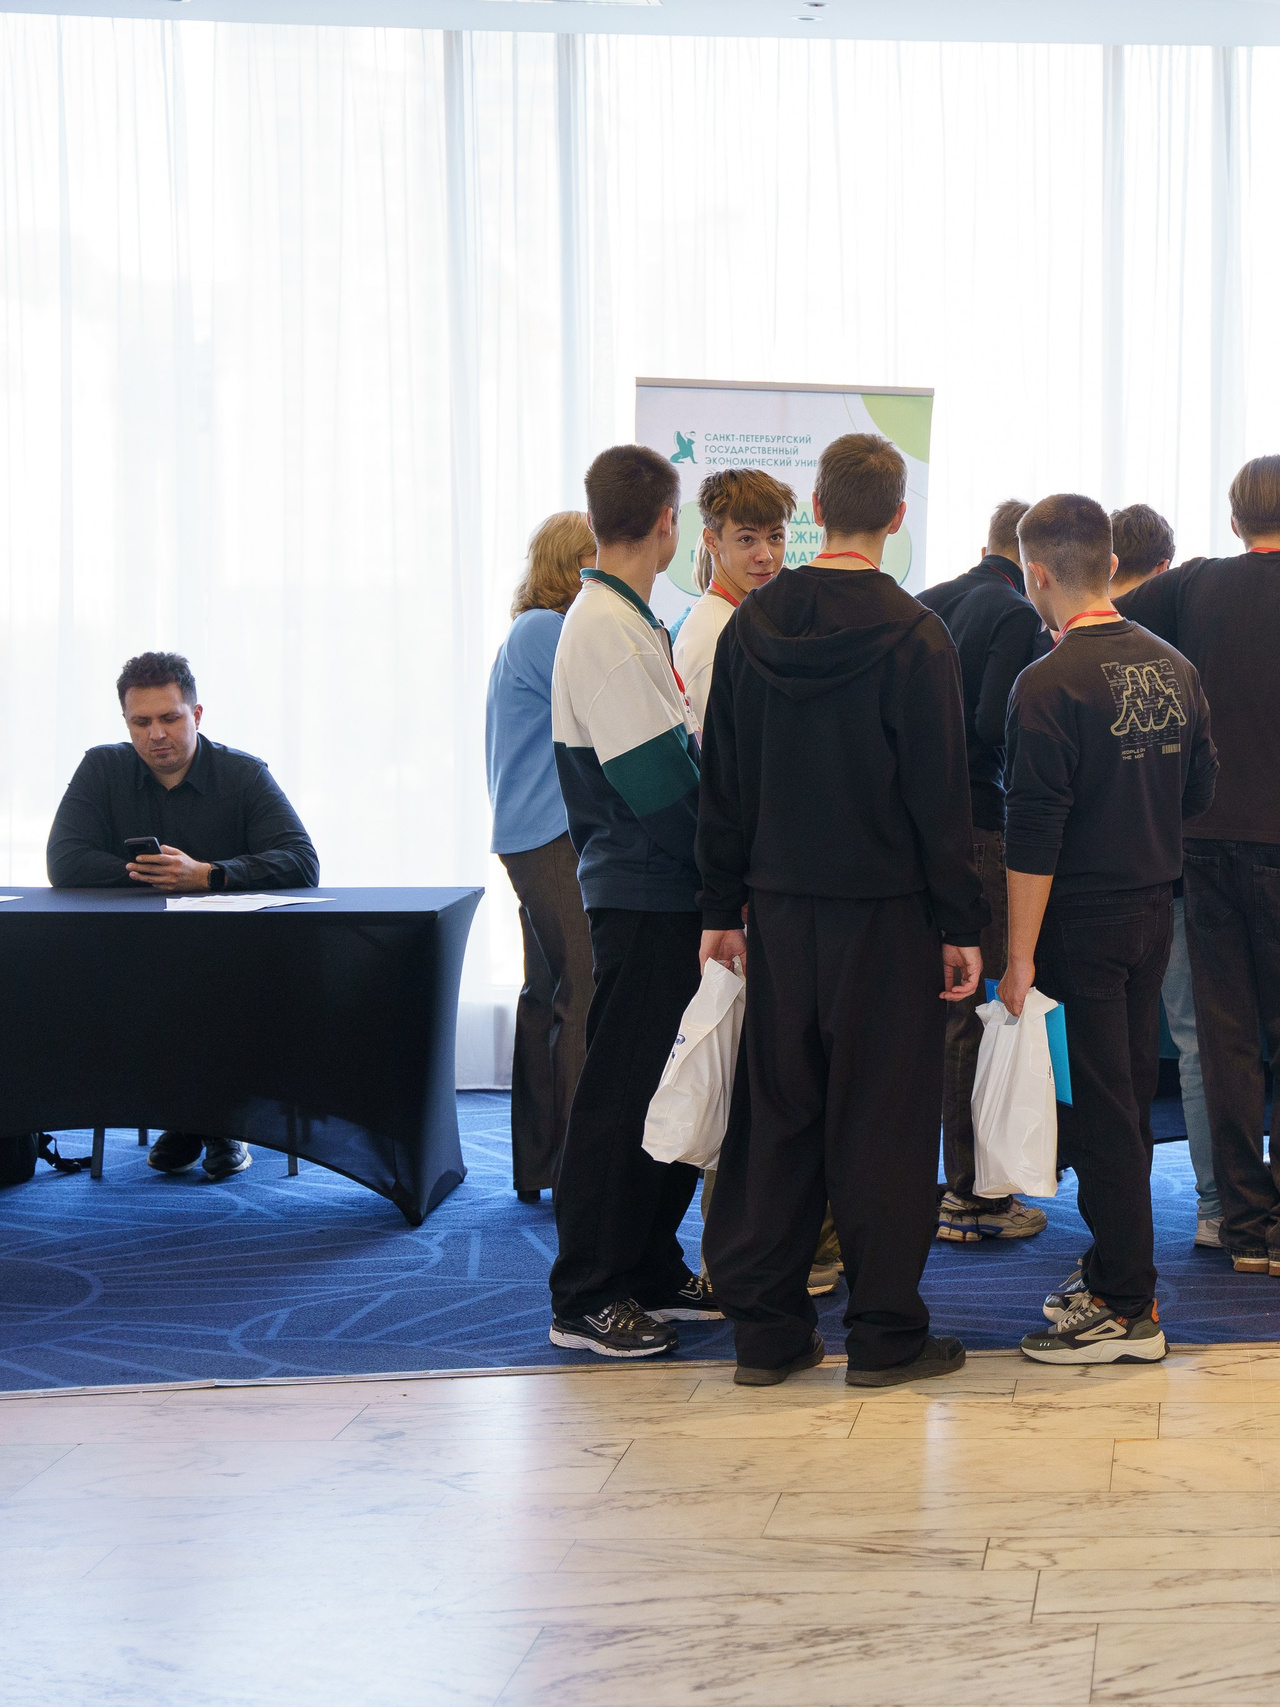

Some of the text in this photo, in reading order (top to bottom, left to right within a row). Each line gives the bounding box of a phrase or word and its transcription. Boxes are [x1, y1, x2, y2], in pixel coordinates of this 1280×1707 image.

[704, 433, 811, 444] САНКТ-ПЕТЕРБУРГСКИЙ
[704, 445, 799, 455] ГОСУДАРСТВЕННЫЙ
[705, 457, 792, 467] ЭКОНОМИЧЕСКИЙ
